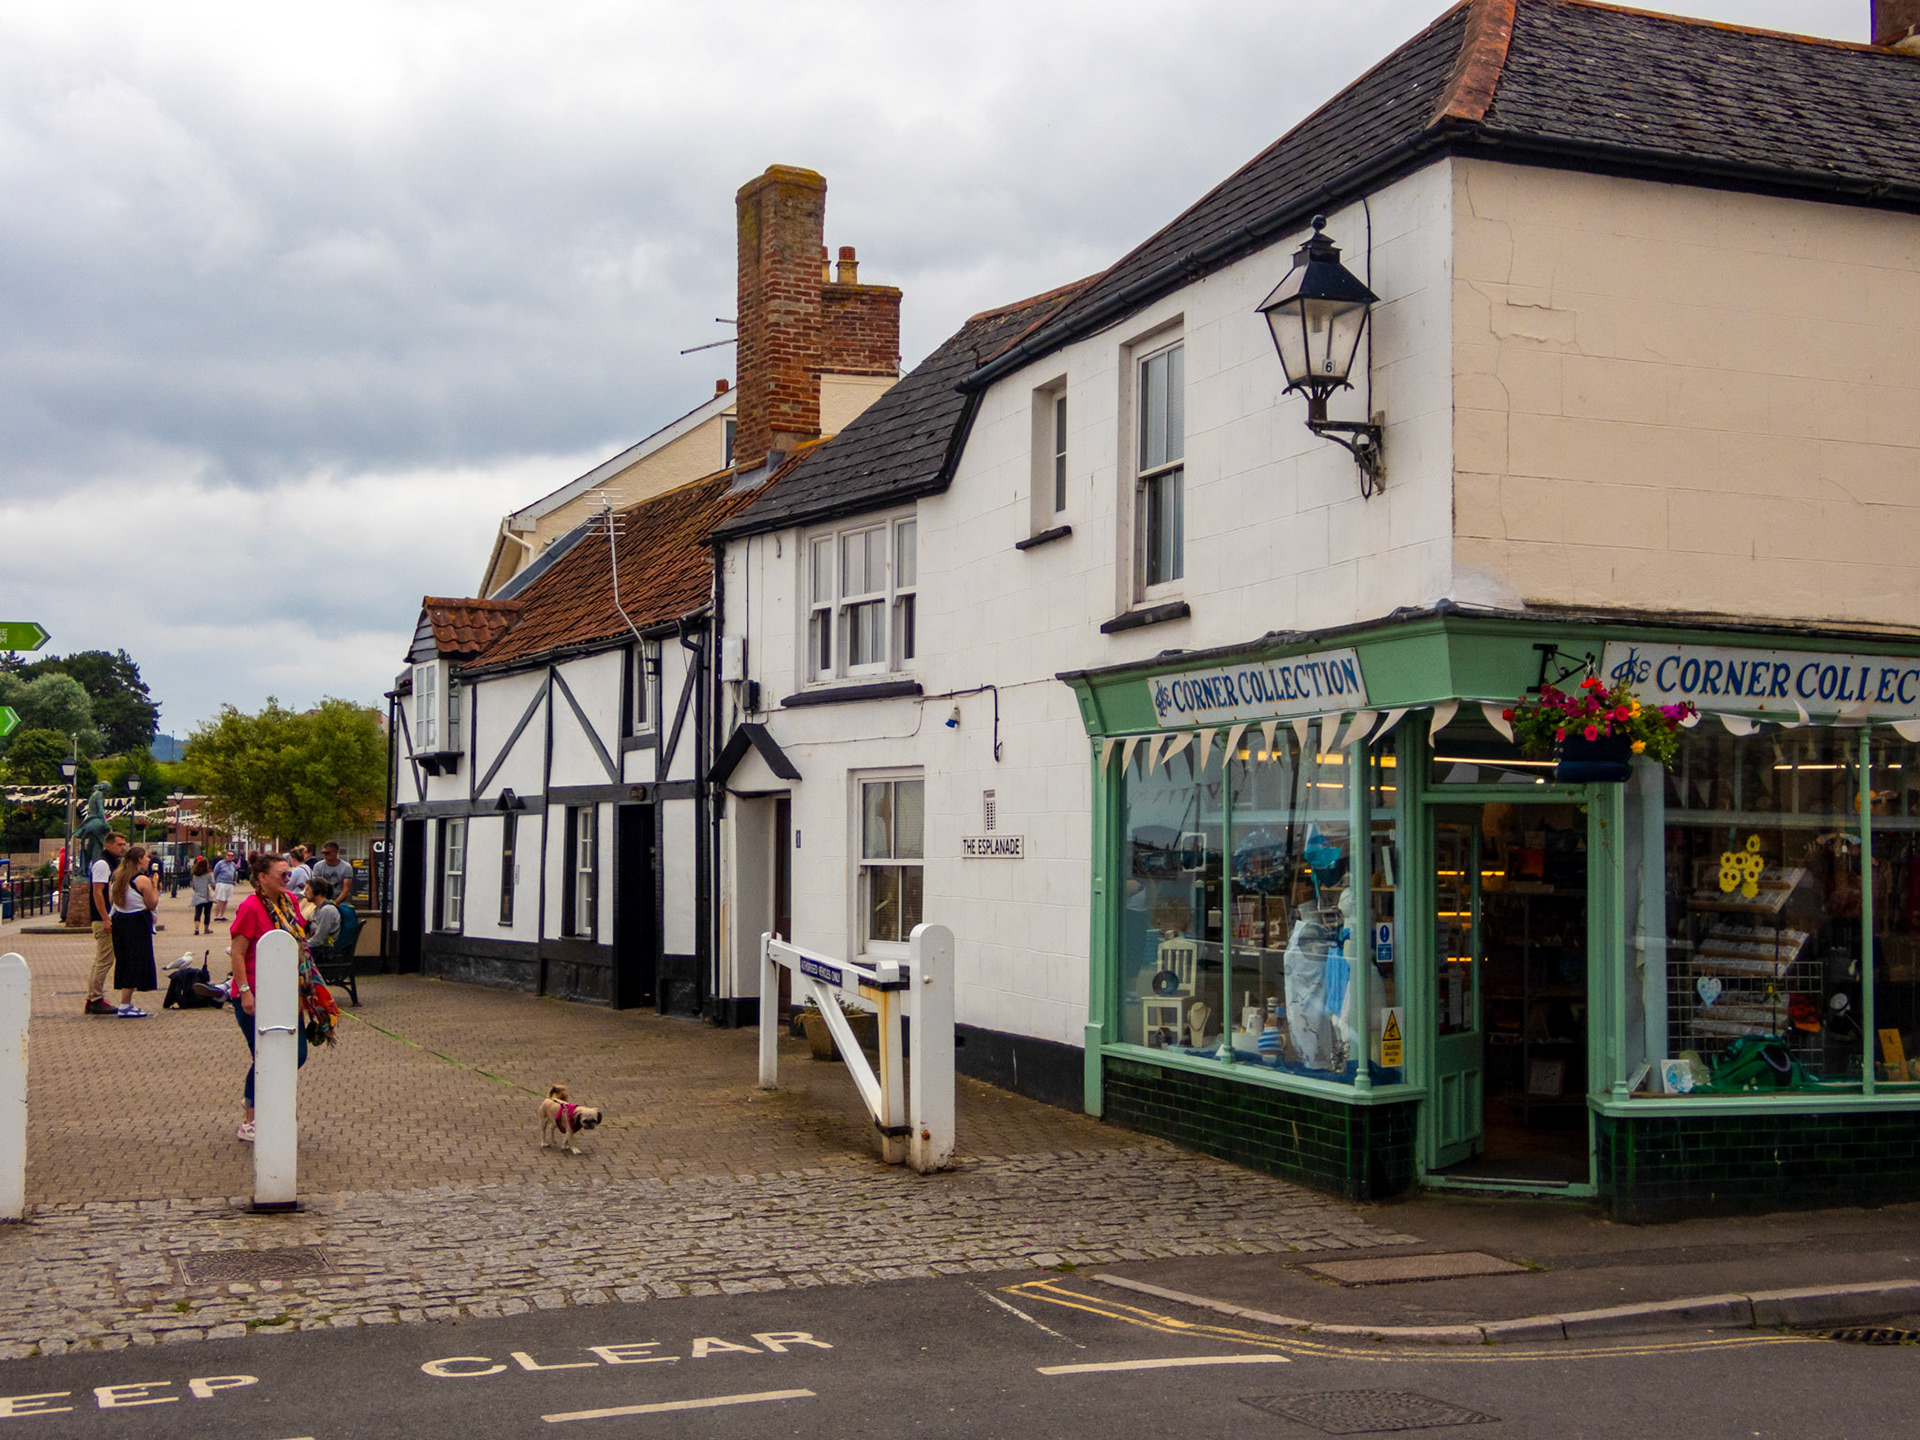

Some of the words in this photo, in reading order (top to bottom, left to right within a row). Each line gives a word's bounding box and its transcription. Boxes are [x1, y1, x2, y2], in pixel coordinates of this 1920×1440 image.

[1325, 361, 1333, 373] 6
[1171, 673, 1240, 713] CORNER
[1237, 658, 1360, 705] COLLECTION
[1656, 655, 1791, 698] CORNER
[963, 838, 976, 855] THE
[978, 838, 1020, 855] ESPLANADE
[420, 1331, 833, 1377] CLEAR
